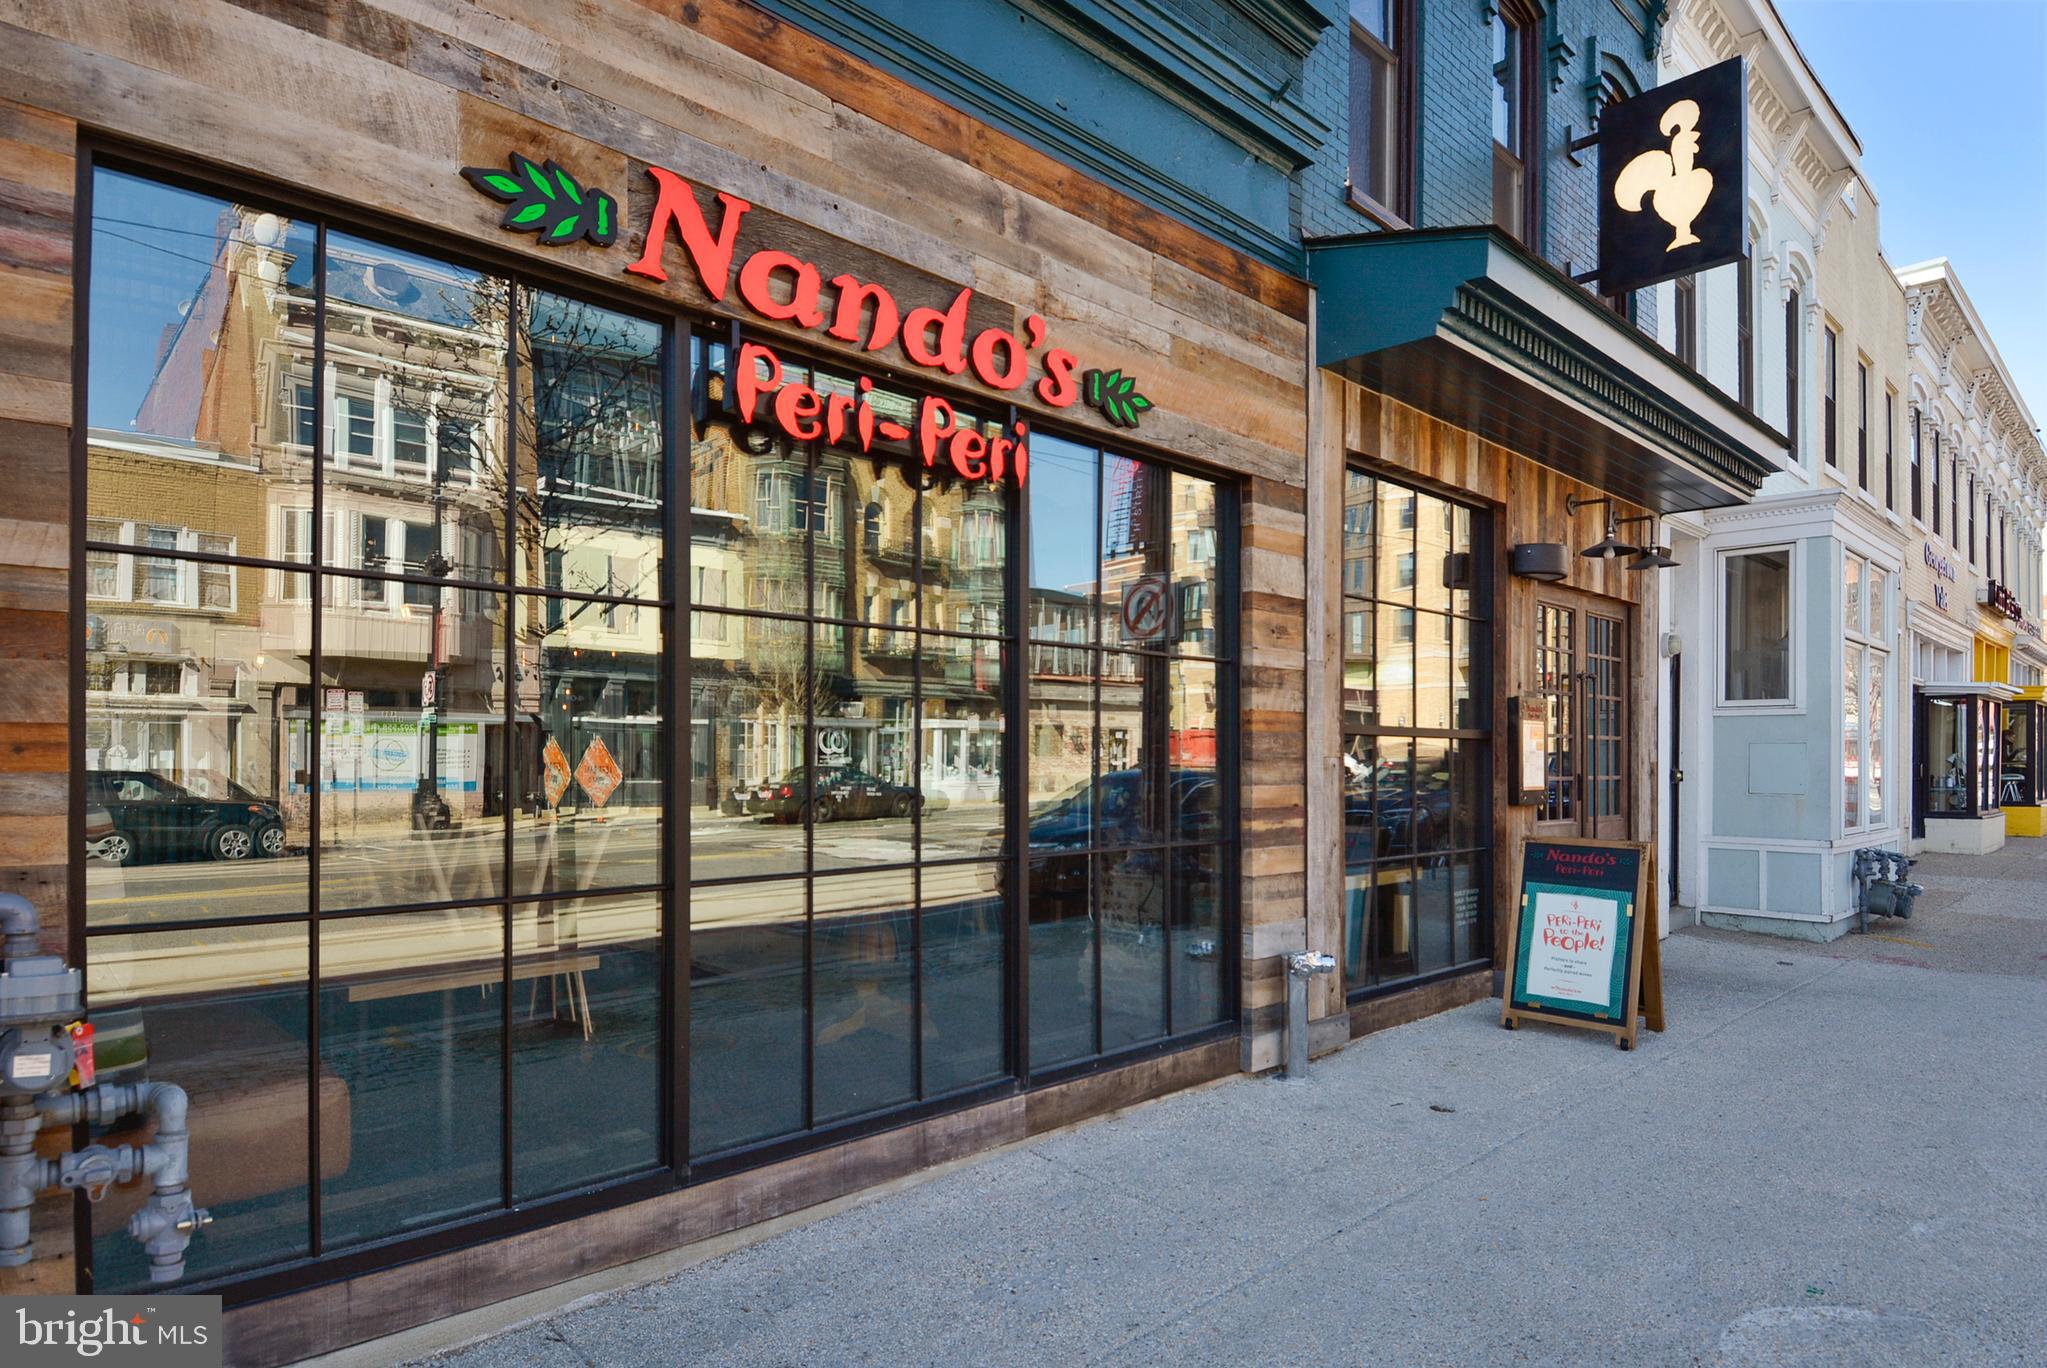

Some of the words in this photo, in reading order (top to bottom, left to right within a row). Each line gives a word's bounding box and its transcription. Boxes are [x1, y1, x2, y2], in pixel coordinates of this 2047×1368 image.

[626, 166, 1079, 408] Nando's
[735, 342, 1027, 488] Peri-Peri
[1546, 848, 1617, 866] Nando's
